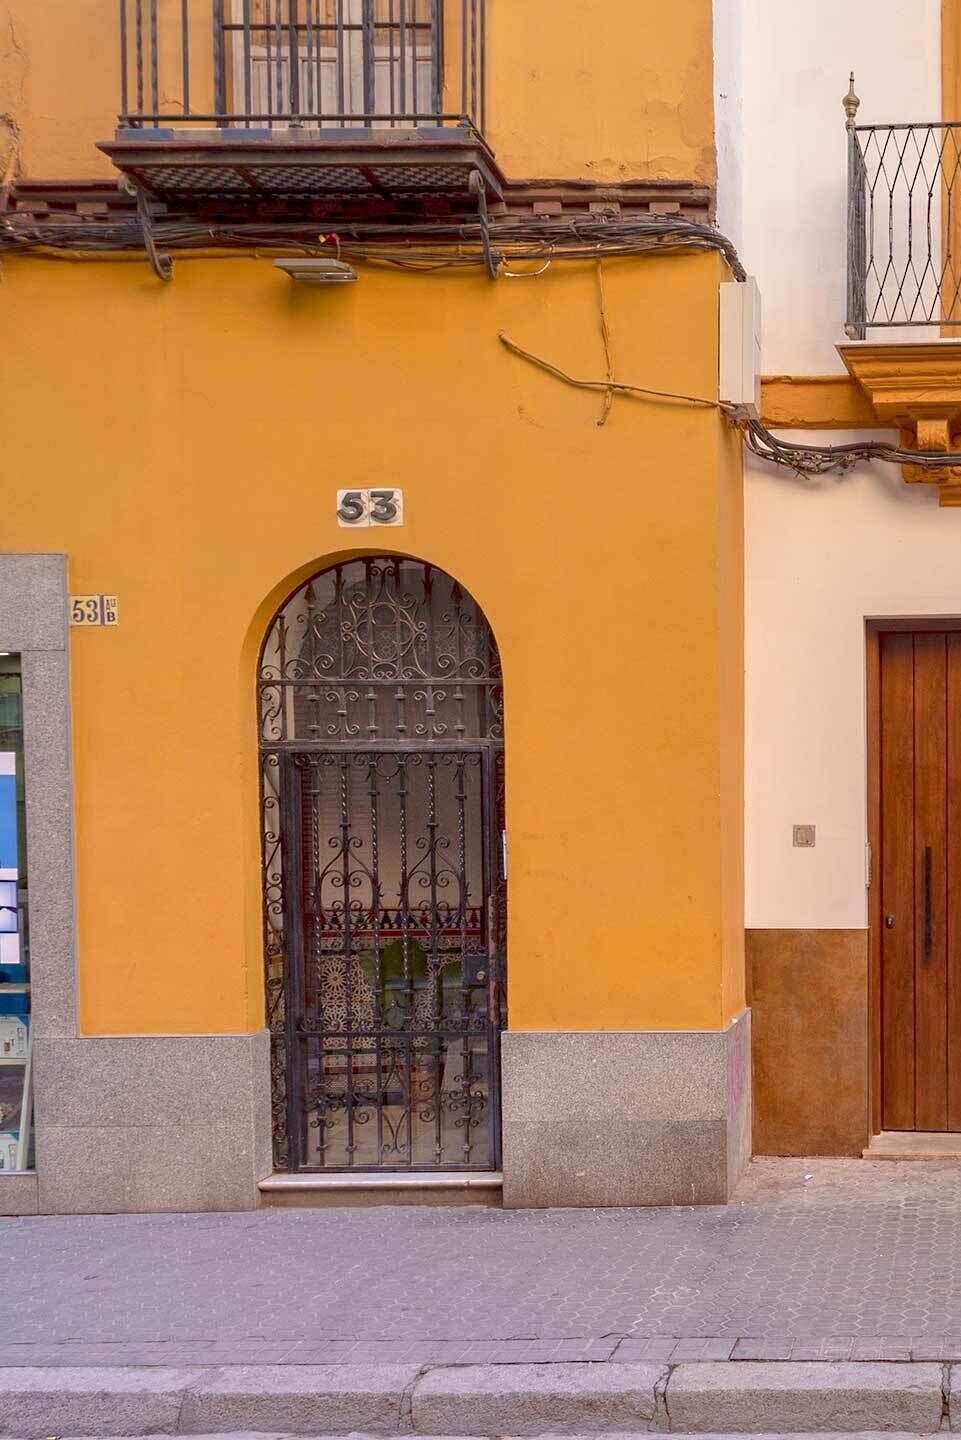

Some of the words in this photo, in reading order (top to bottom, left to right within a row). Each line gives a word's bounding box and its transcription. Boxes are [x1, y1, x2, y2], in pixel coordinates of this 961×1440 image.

[337, 490, 397, 523] 53
[72, 599, 99, 623] 53
[106, 611, 116, 623] B
